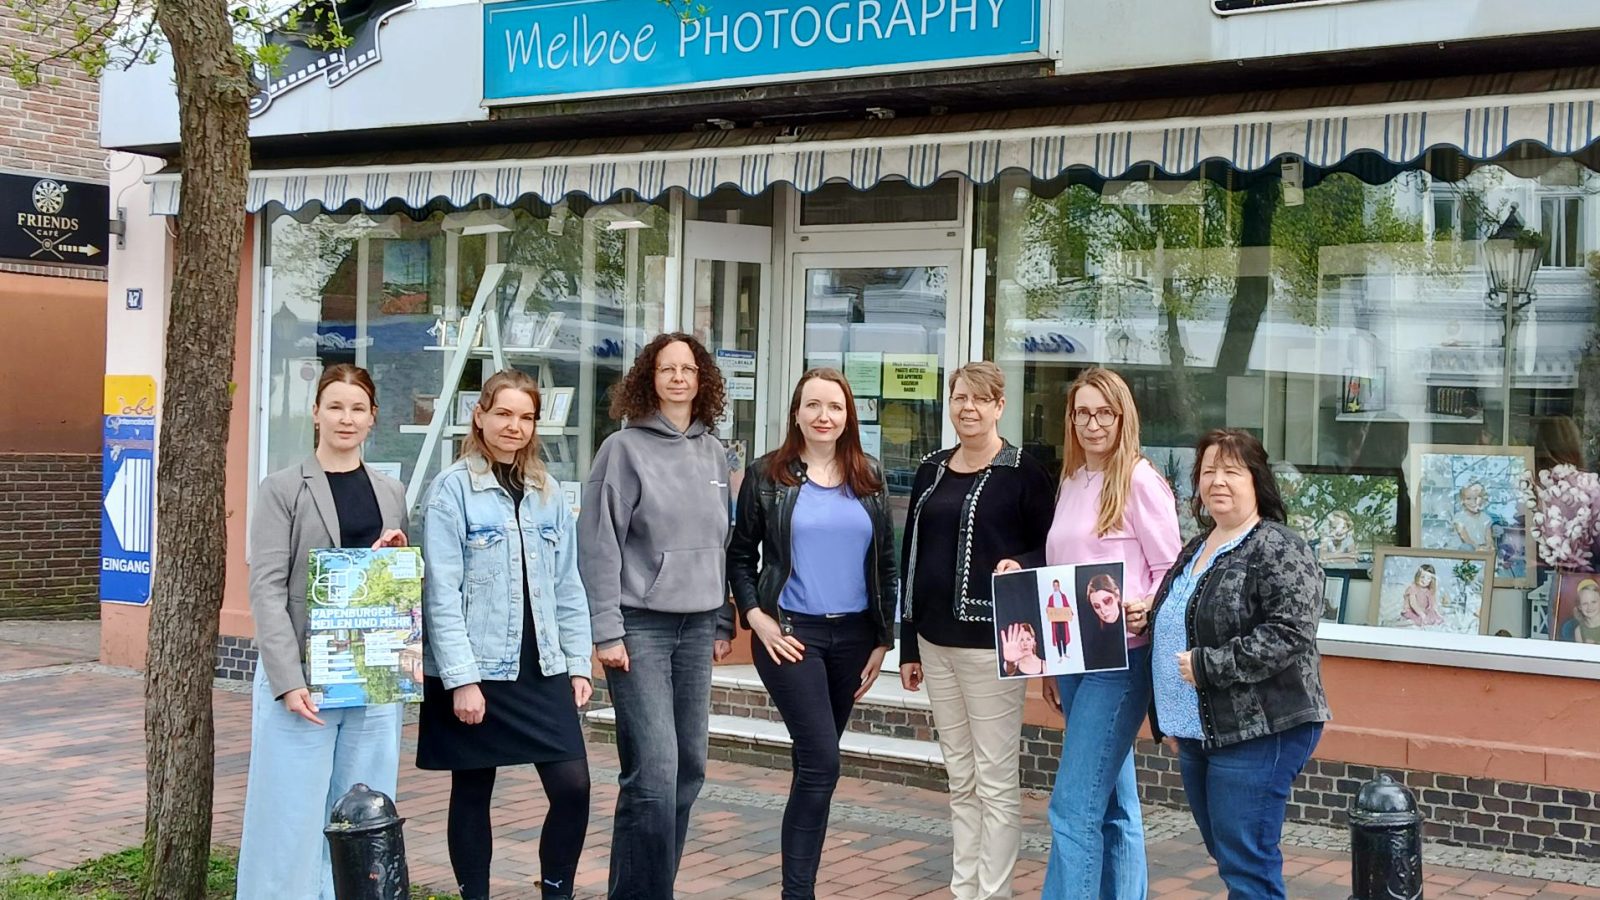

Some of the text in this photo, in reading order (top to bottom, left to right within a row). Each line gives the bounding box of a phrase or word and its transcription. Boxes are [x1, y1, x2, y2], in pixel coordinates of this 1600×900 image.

[505, 0, 1003, 73] Melboe PHOTOGRAPHY
[17, 212, 79, 231] FRIENDS
[102, 557, 150, 574] EINGANG
[311, 606, 392, 618] PAPENBURGER
[354, 617, 379, 628] UND
[381, 616, 411, 627] MEHR
